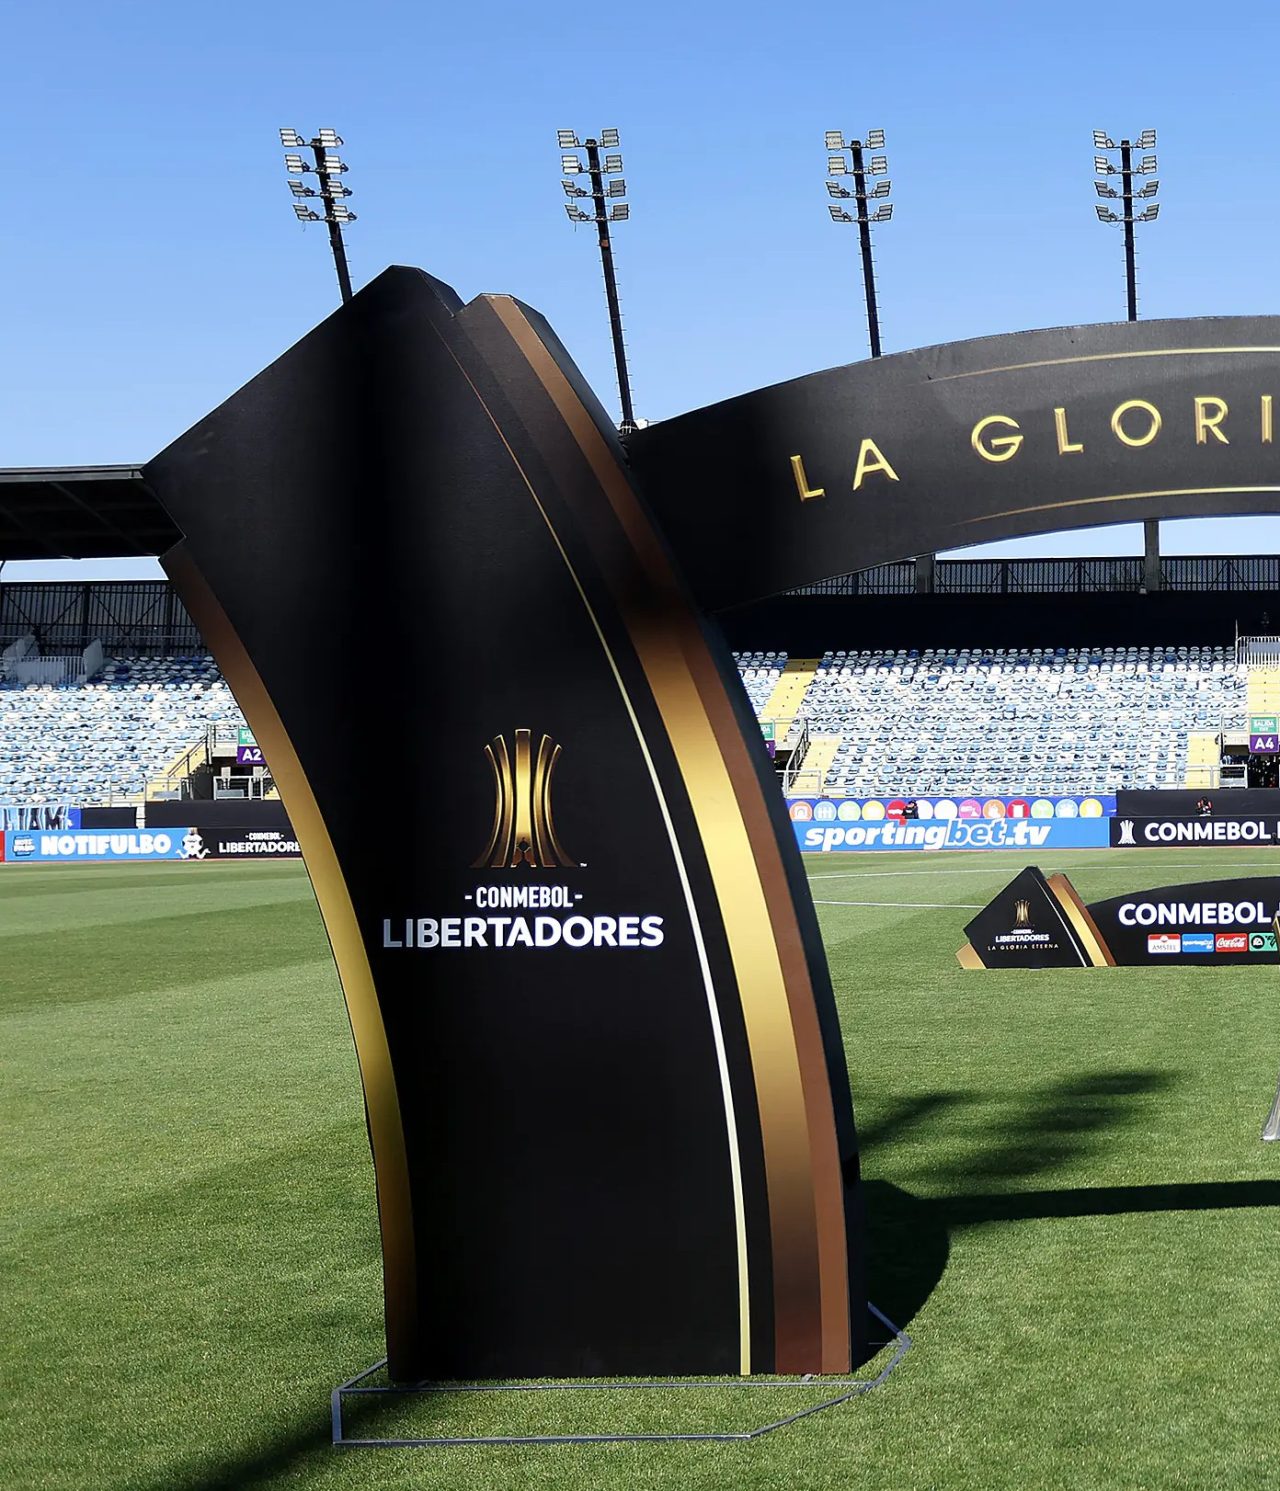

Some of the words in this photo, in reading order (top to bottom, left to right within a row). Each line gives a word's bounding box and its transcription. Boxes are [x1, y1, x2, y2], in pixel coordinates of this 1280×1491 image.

[790, 455, 900, 501] LA
[242, 748, 262, 761] A2
[1255, 737, 1275, 750] A4
[1144, 820, 1273, 841] CONMEBOL
[41, 834, 172, 856] NOTIFULBO
[1118, 902, 1271, 926] CONMEBOL
[383, 916, 664, 948] LIBERTADORES
